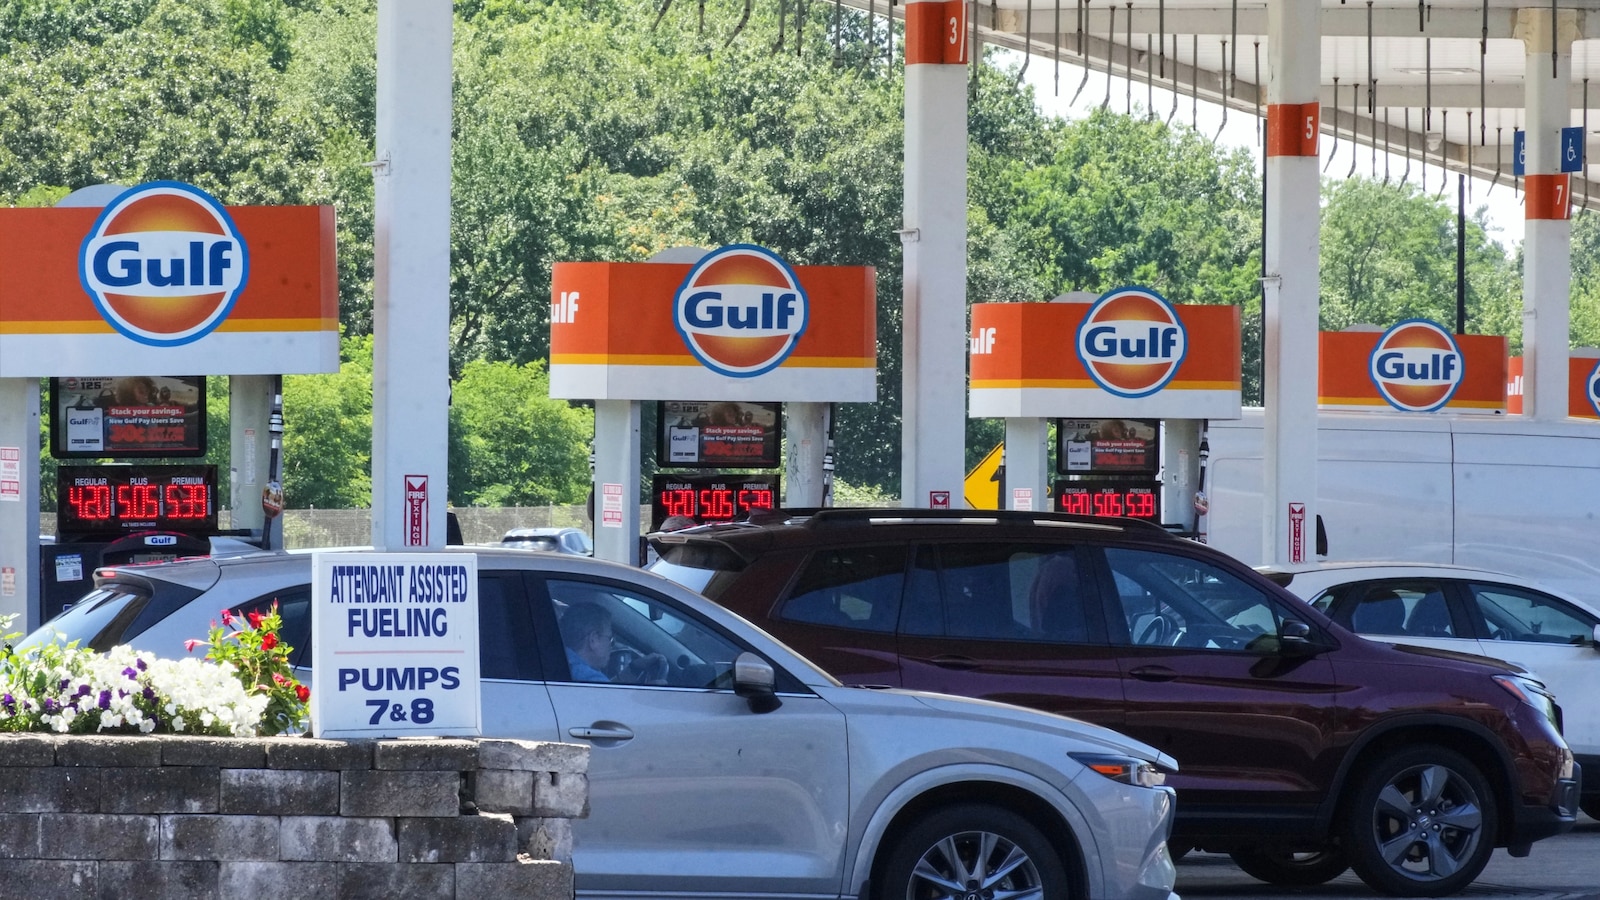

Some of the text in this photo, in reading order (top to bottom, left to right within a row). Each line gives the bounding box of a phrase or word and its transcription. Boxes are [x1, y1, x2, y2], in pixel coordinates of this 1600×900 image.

[949, 16, 957, 45] 3
[1305, 116, 1313, 139] 5
[1555, 184, 1563, 205] 7
[93, 241, 232, 287] Gulf
[551, 291, 580, 324] ulf
[684, 291, 797, 330] Gulf
[971, 327, 996, 355] ulf
[1084, 326, 1177, 358] Gulf
[1376, 352, 1456, 380] Gulf
[81, 382, 102, 390] 125
[111, 407, 182, 417] Stack your savings.
[75, 477, 203, 486] REGULAR PLUS PREMIUM
[408, 491, 425, 499] FIRE
[69, 486, 110, 518] 4.20
[118, 485, 158, 518] 5.05
[166, 485, 206, 518] 5.39
[700, 490, 733, 517] 5.05
[739, 490, 771, 512] 539
[1062, 493, 1090, 515] 420
[1094, 493, 1122, 516] 5.05
[1126, 493, 1153, 516] 5.39
[412, 500, 420, 546] EXTINGU
[331, 565, 468, 603] ATTENDANT ASSISTED
[348, 607, 448, 637] FUELING
[338, 666, 460, 691] PUMPS
[365, 698, 435, 725] 7&8
